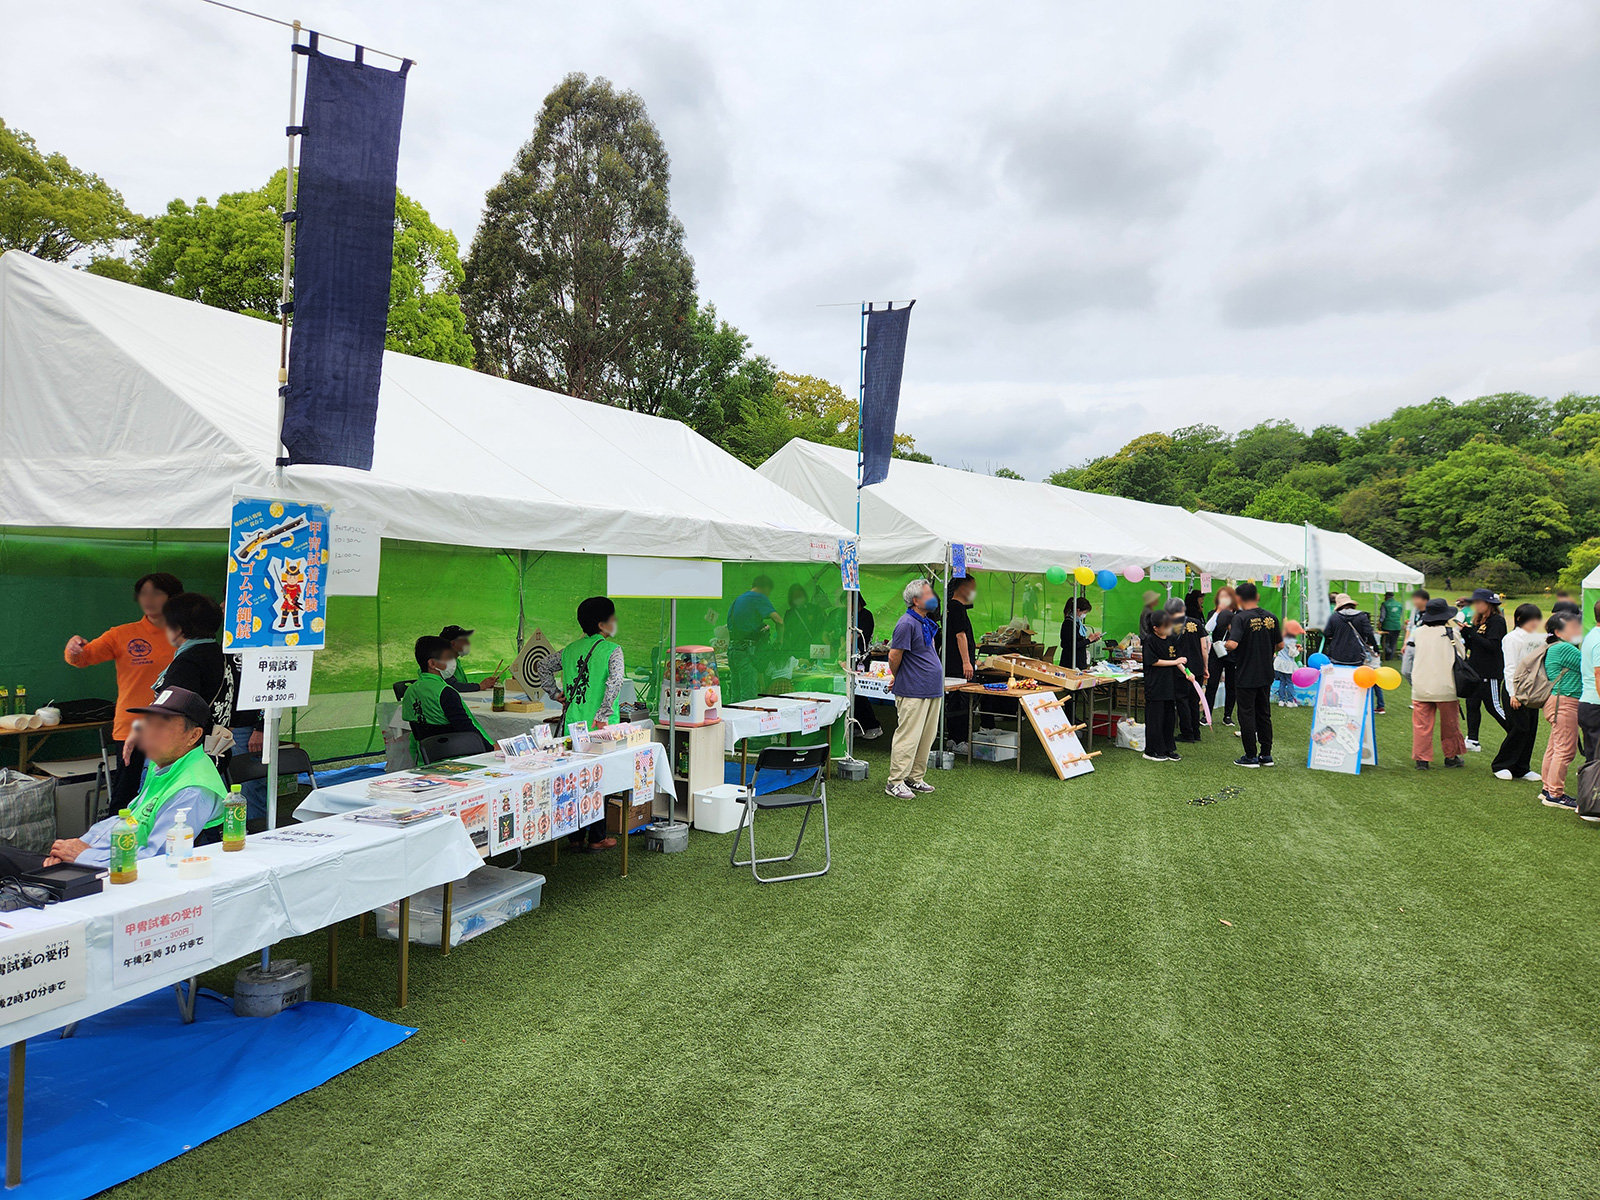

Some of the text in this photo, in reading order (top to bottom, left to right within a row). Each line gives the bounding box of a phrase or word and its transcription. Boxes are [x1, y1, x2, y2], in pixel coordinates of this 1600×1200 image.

[305, 521, 322, 613] 甲冑試着体験
[235, 562, 256, 639] ゴム火縄銃
[258, 660, 298, 672] 甲冑試着
[266, 678, 287, 691] 体験
[125, 904, 203, 936] 甲冑試着の受付
